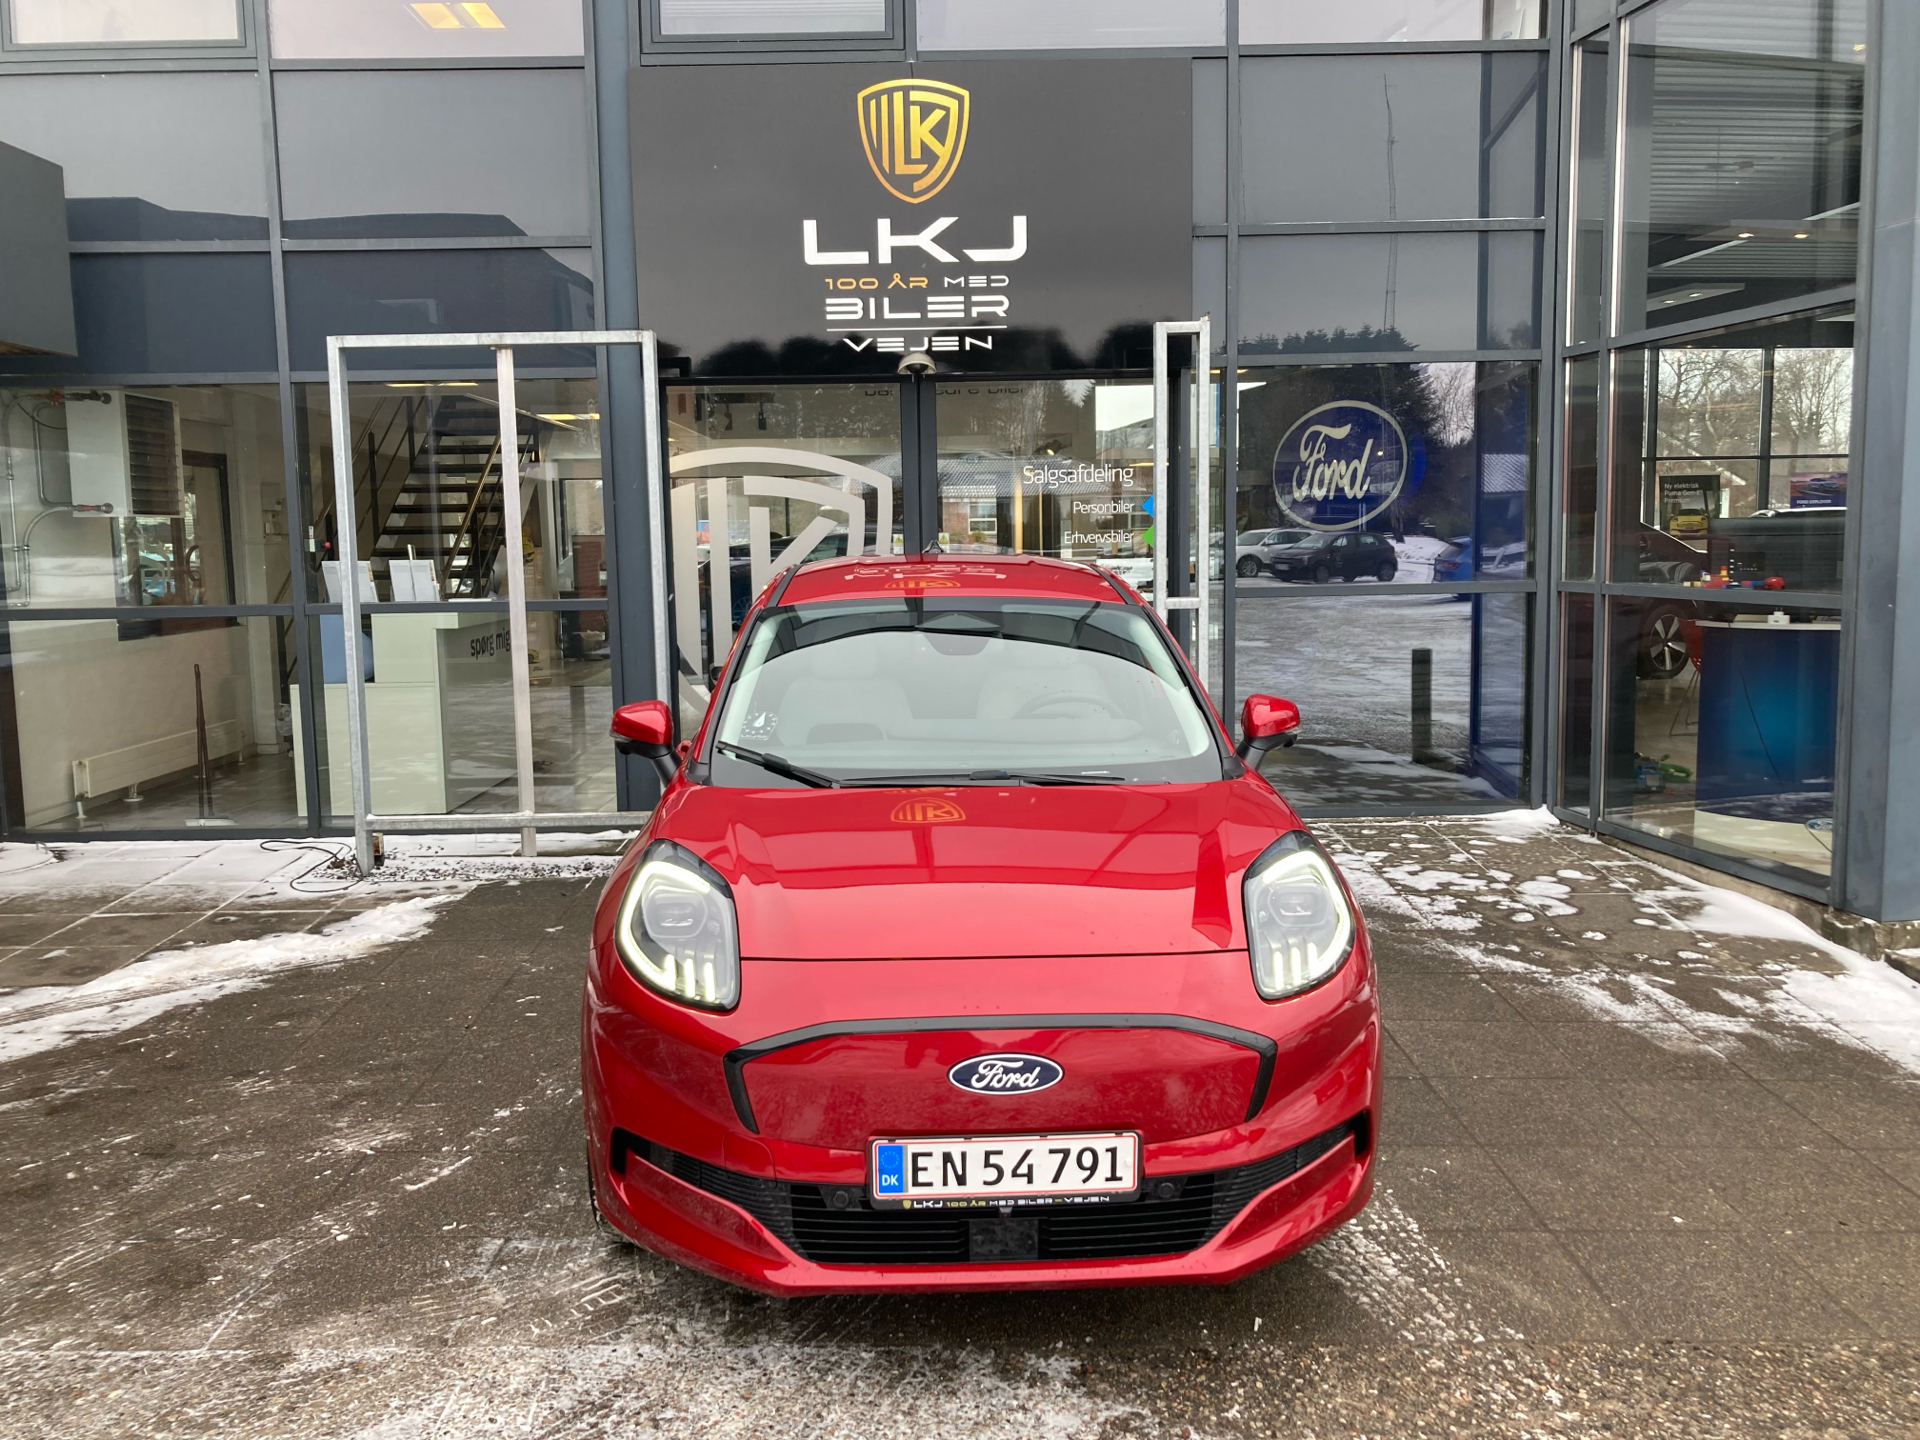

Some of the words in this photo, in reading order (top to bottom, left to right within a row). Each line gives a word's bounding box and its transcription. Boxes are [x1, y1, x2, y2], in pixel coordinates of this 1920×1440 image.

[803, 215, 1028, 265] LKJ
[824, 278, 879, 290] 100
[887, 272, 929, 289] ÅR
[944, 275, 1010, 288] MED
[825, 295, 1010, 320] BILER
[843, 335, 993, 352] VEJEN
[1292, 423, 1374, 502] Ford
[1023, 464, 1134, 488] Salgsafdeling
[1073, 500, 1134, 514] Personbiler
[1064, 530, 1134, 544] Erhvervsbiler
[470, 633, 494, 660] spørg
[495, 627, 511, 652] mig
[971, 1060, 1041, 1088] Ford
[911, 1151, 967, 1187] EN
[982, 1149, 1034, 1186] 54
[1048, 1146, 1123, 1184] 791
[881, 1174, 899, 1186] DK
[913, 1200, 943, 1208] LKJ
